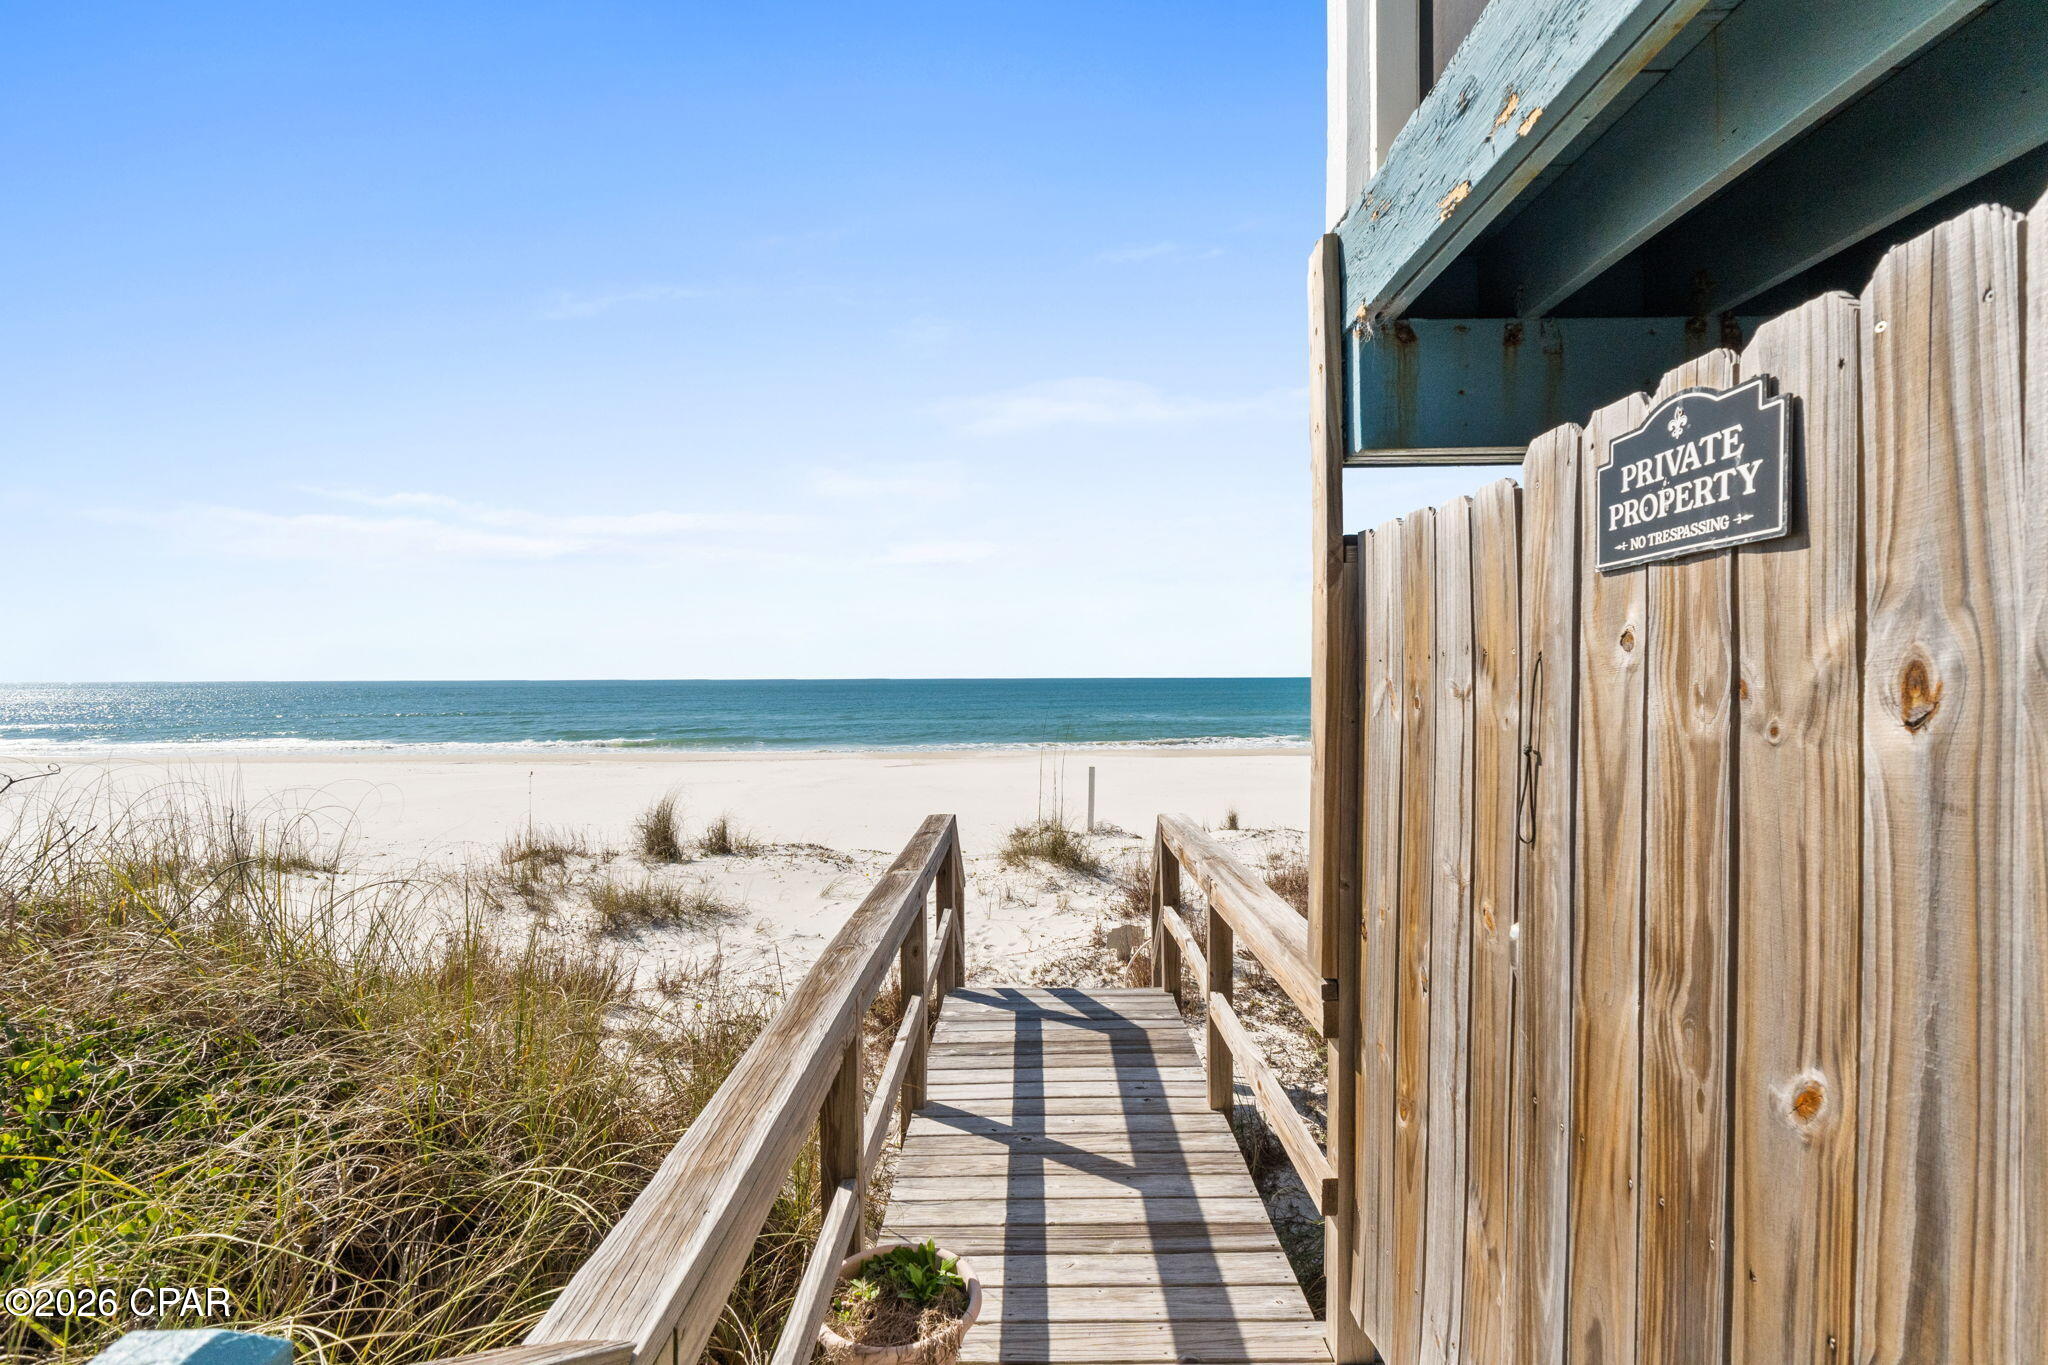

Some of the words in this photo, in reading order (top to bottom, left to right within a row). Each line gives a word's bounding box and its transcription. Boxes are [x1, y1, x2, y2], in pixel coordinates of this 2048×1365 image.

[1620, 424, 1744, 494] PRIVATE
[1608, 459, 1763, 531] PROPERTY
[1630, 533, 1646, 550] NO
[1647, 515, 1730, 546] TRESPASSING
